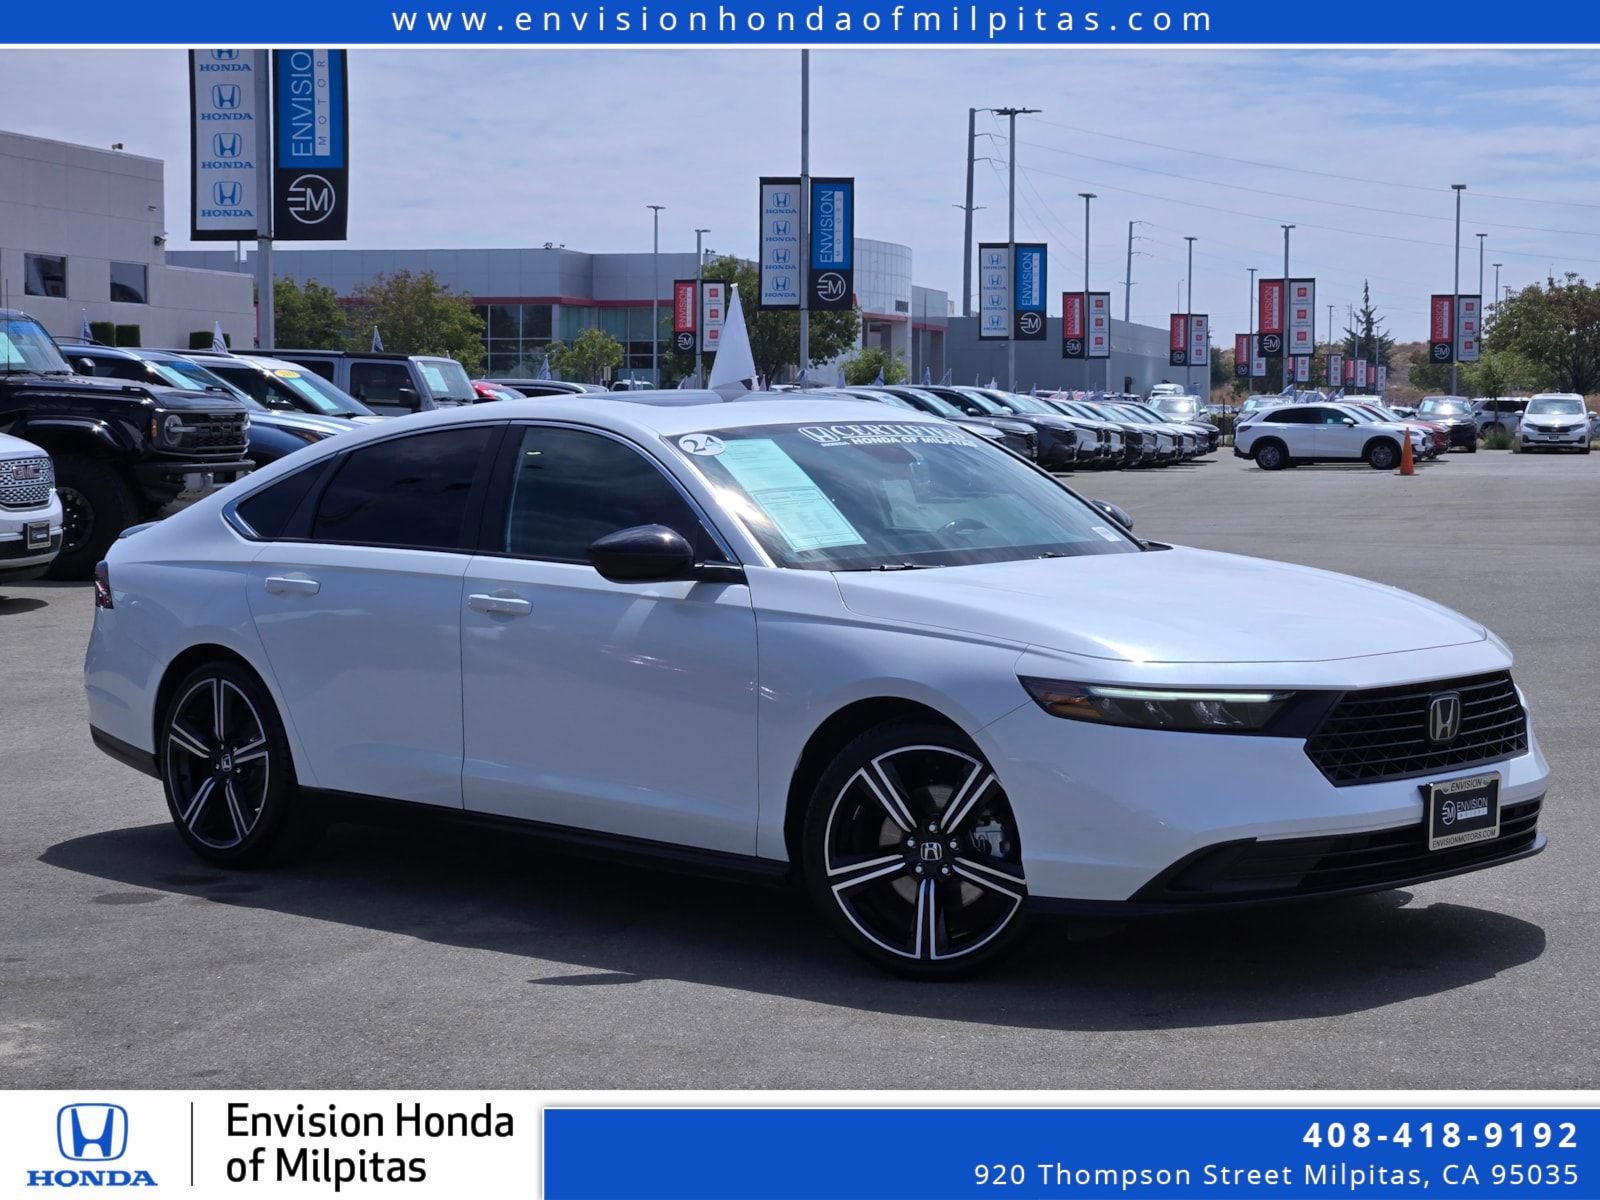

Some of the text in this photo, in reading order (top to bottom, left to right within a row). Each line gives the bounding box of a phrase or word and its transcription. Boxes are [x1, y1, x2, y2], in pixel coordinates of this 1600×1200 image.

[201, 161, 254, 169] HONDA
[201, 209, 253, 217] HONDA
[820, 190, 834, 263] ENVISION
[1022, 252, 1032, 306] ENVISION
[679, 286, 687, 328] ENVISION
[1264, 286, 1273, 330] ENVISION
[683, 436, 723, 453] 24
[851, 436, 901, 445] HONDA
[13, 464, 41, 480] GMC
[1451, 779, 1483, 792] ENVISION
[1456, 796, 1488, 811] ENVISION
[1432, 828, 1496, 849] ENVISIONMOTORS.COM
